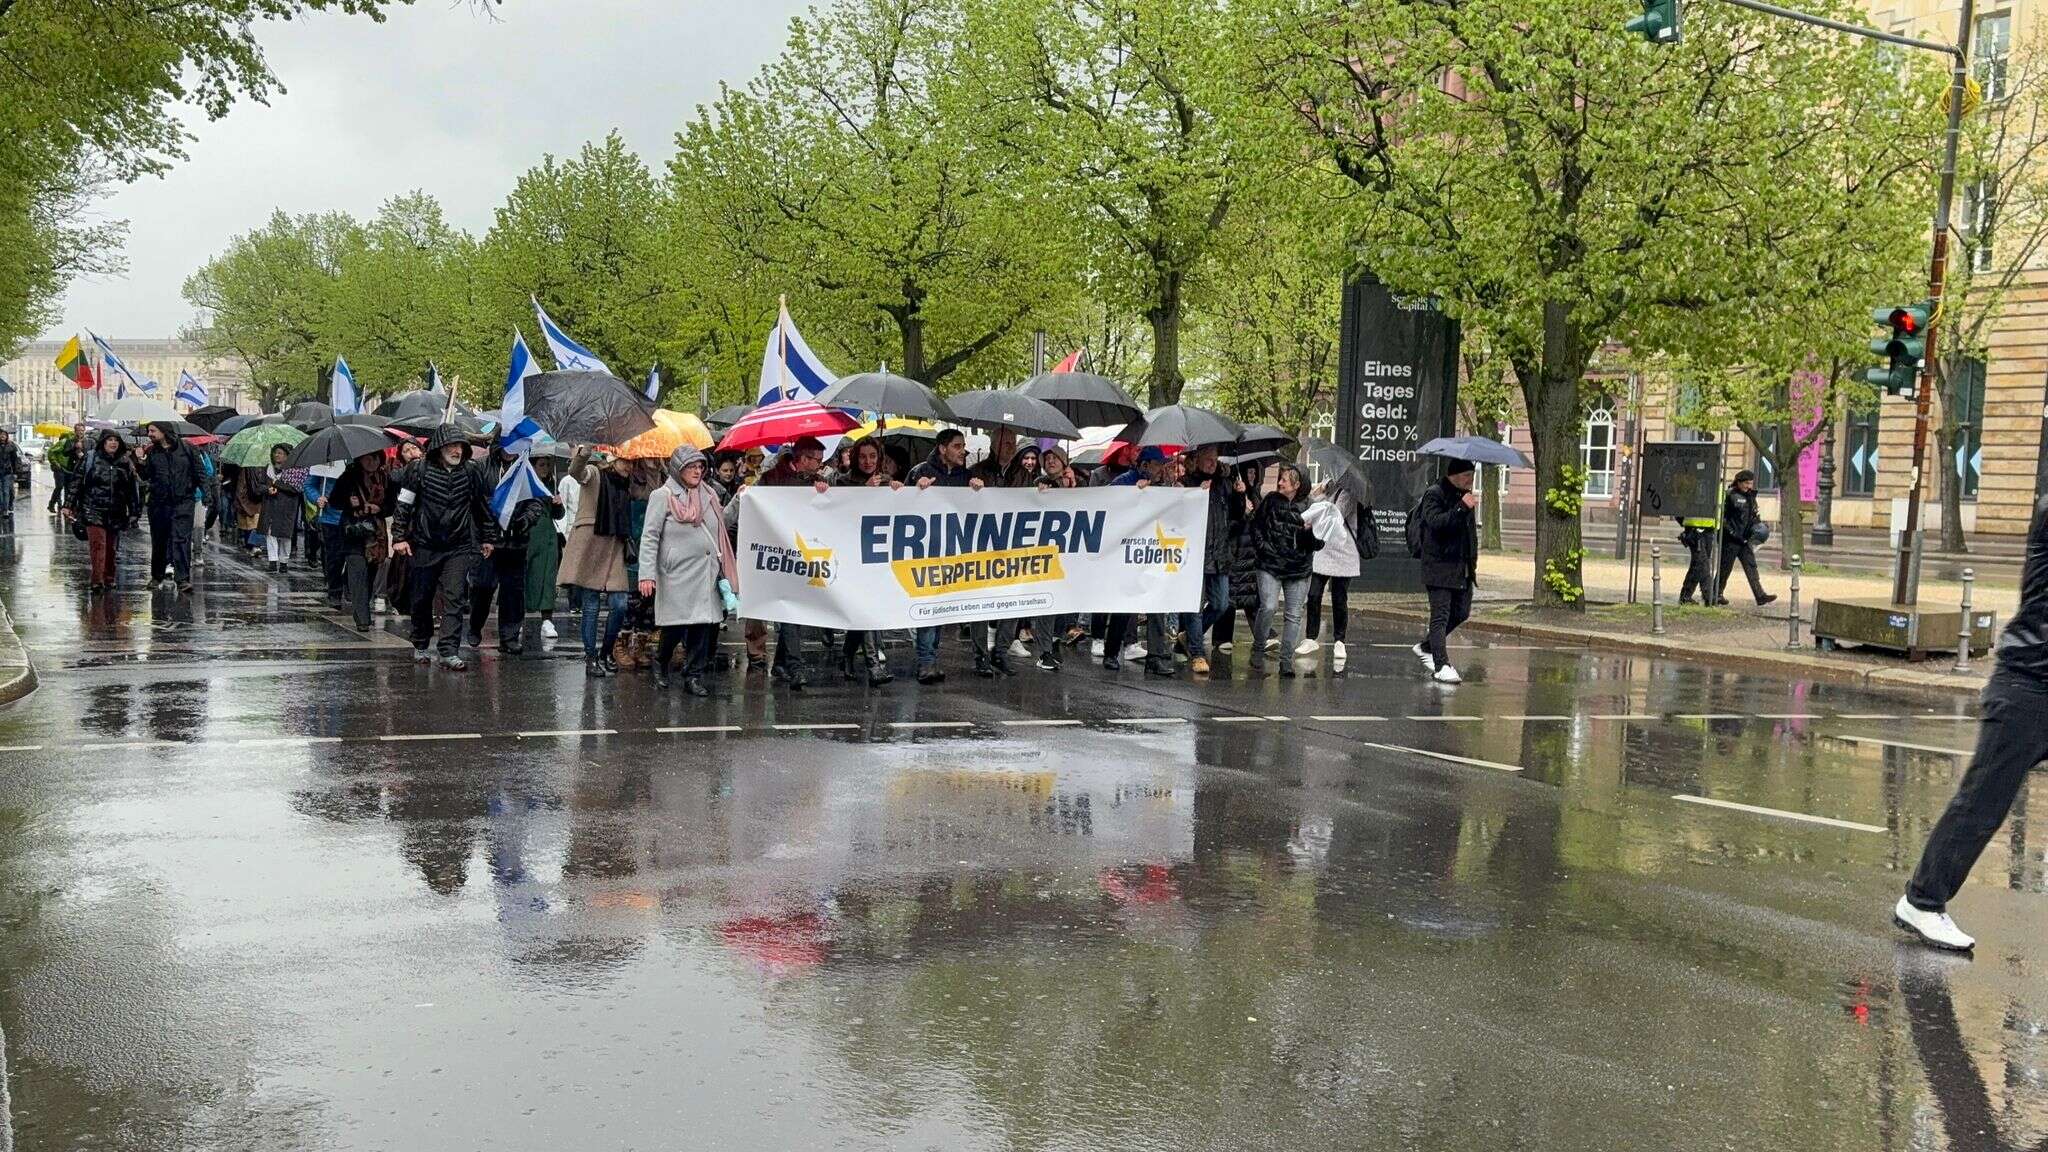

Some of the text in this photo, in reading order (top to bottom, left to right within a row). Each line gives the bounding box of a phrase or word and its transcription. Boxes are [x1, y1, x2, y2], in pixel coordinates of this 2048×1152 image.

[1364, 360, 1412, 377] Eines
[1363, 382, 1414, 400] Tages
[1361, 403, 1408, 419] Geld:
[1360, 423, 1418, 442] 2,50 %
[1359, 445, 1416, 462] Zinsen
[860, 510, 1107, 564] ERINNERN
[1148, 537, 1160, 545] des
[750, 542, 802, 557] Marsch des
[1124, 545, 1183, 564] Lebens
[755, 551, 831, 579] Lebens
[910, 554, 1053, 588] VERPFLICHTET
[919, 608, 931, 616] Für
[932, 606, 959, 616] jüdisches
[960, 603, 980, 612] Leben
[981, 601, 995, 609] und
[996, 600, 1017, 609] gegen
